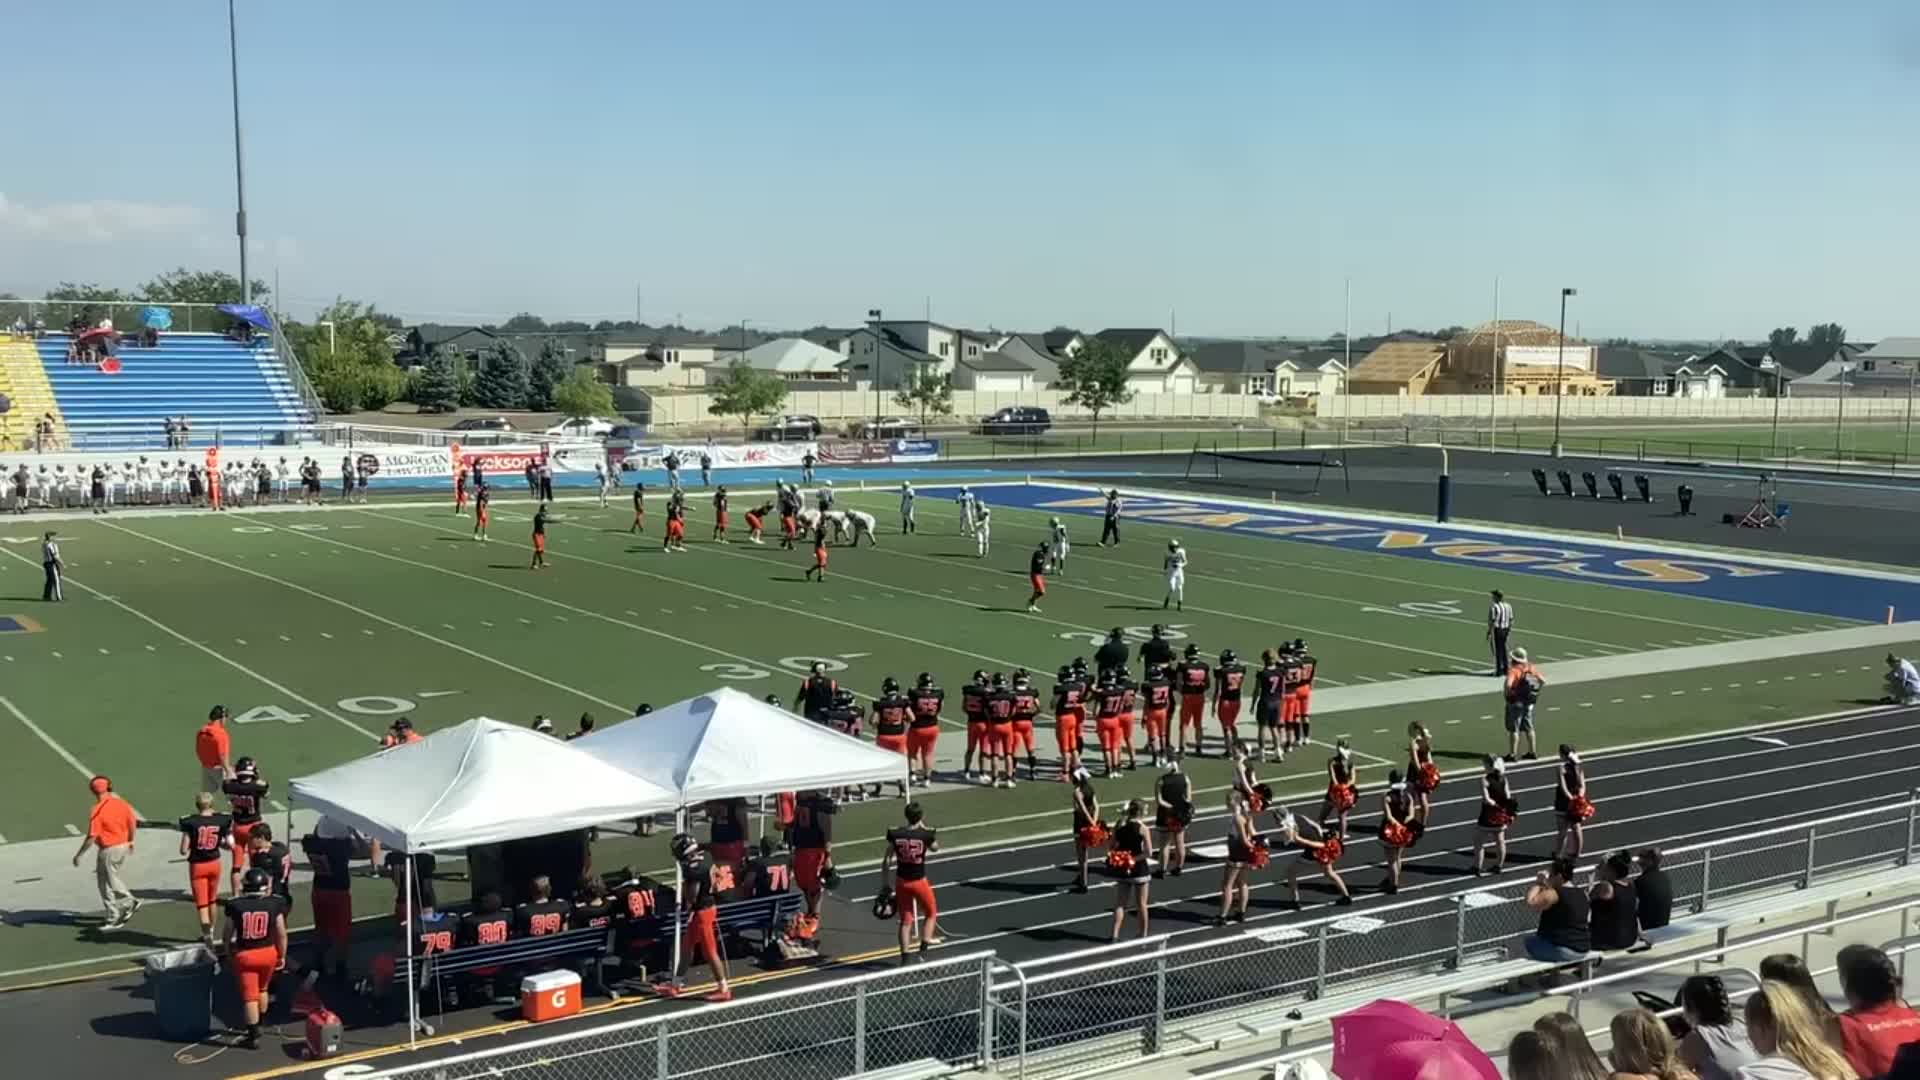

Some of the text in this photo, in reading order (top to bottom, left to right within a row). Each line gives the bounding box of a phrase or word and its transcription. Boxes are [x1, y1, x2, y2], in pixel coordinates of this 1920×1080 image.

[385, 454, 449, 466] MORGAN
[1031, 496, 1784, 583] VIKINGS
[1360, 602, 1462, 617] 10
[699, 656, 848, 679] 30
[234, 696, 416, 723] 40
[766, 864, 788, 891] 71
[242, 911, 269, 940] 10
[420, 931, 452, 958] 79
[552, 989, 567, 1009] G
